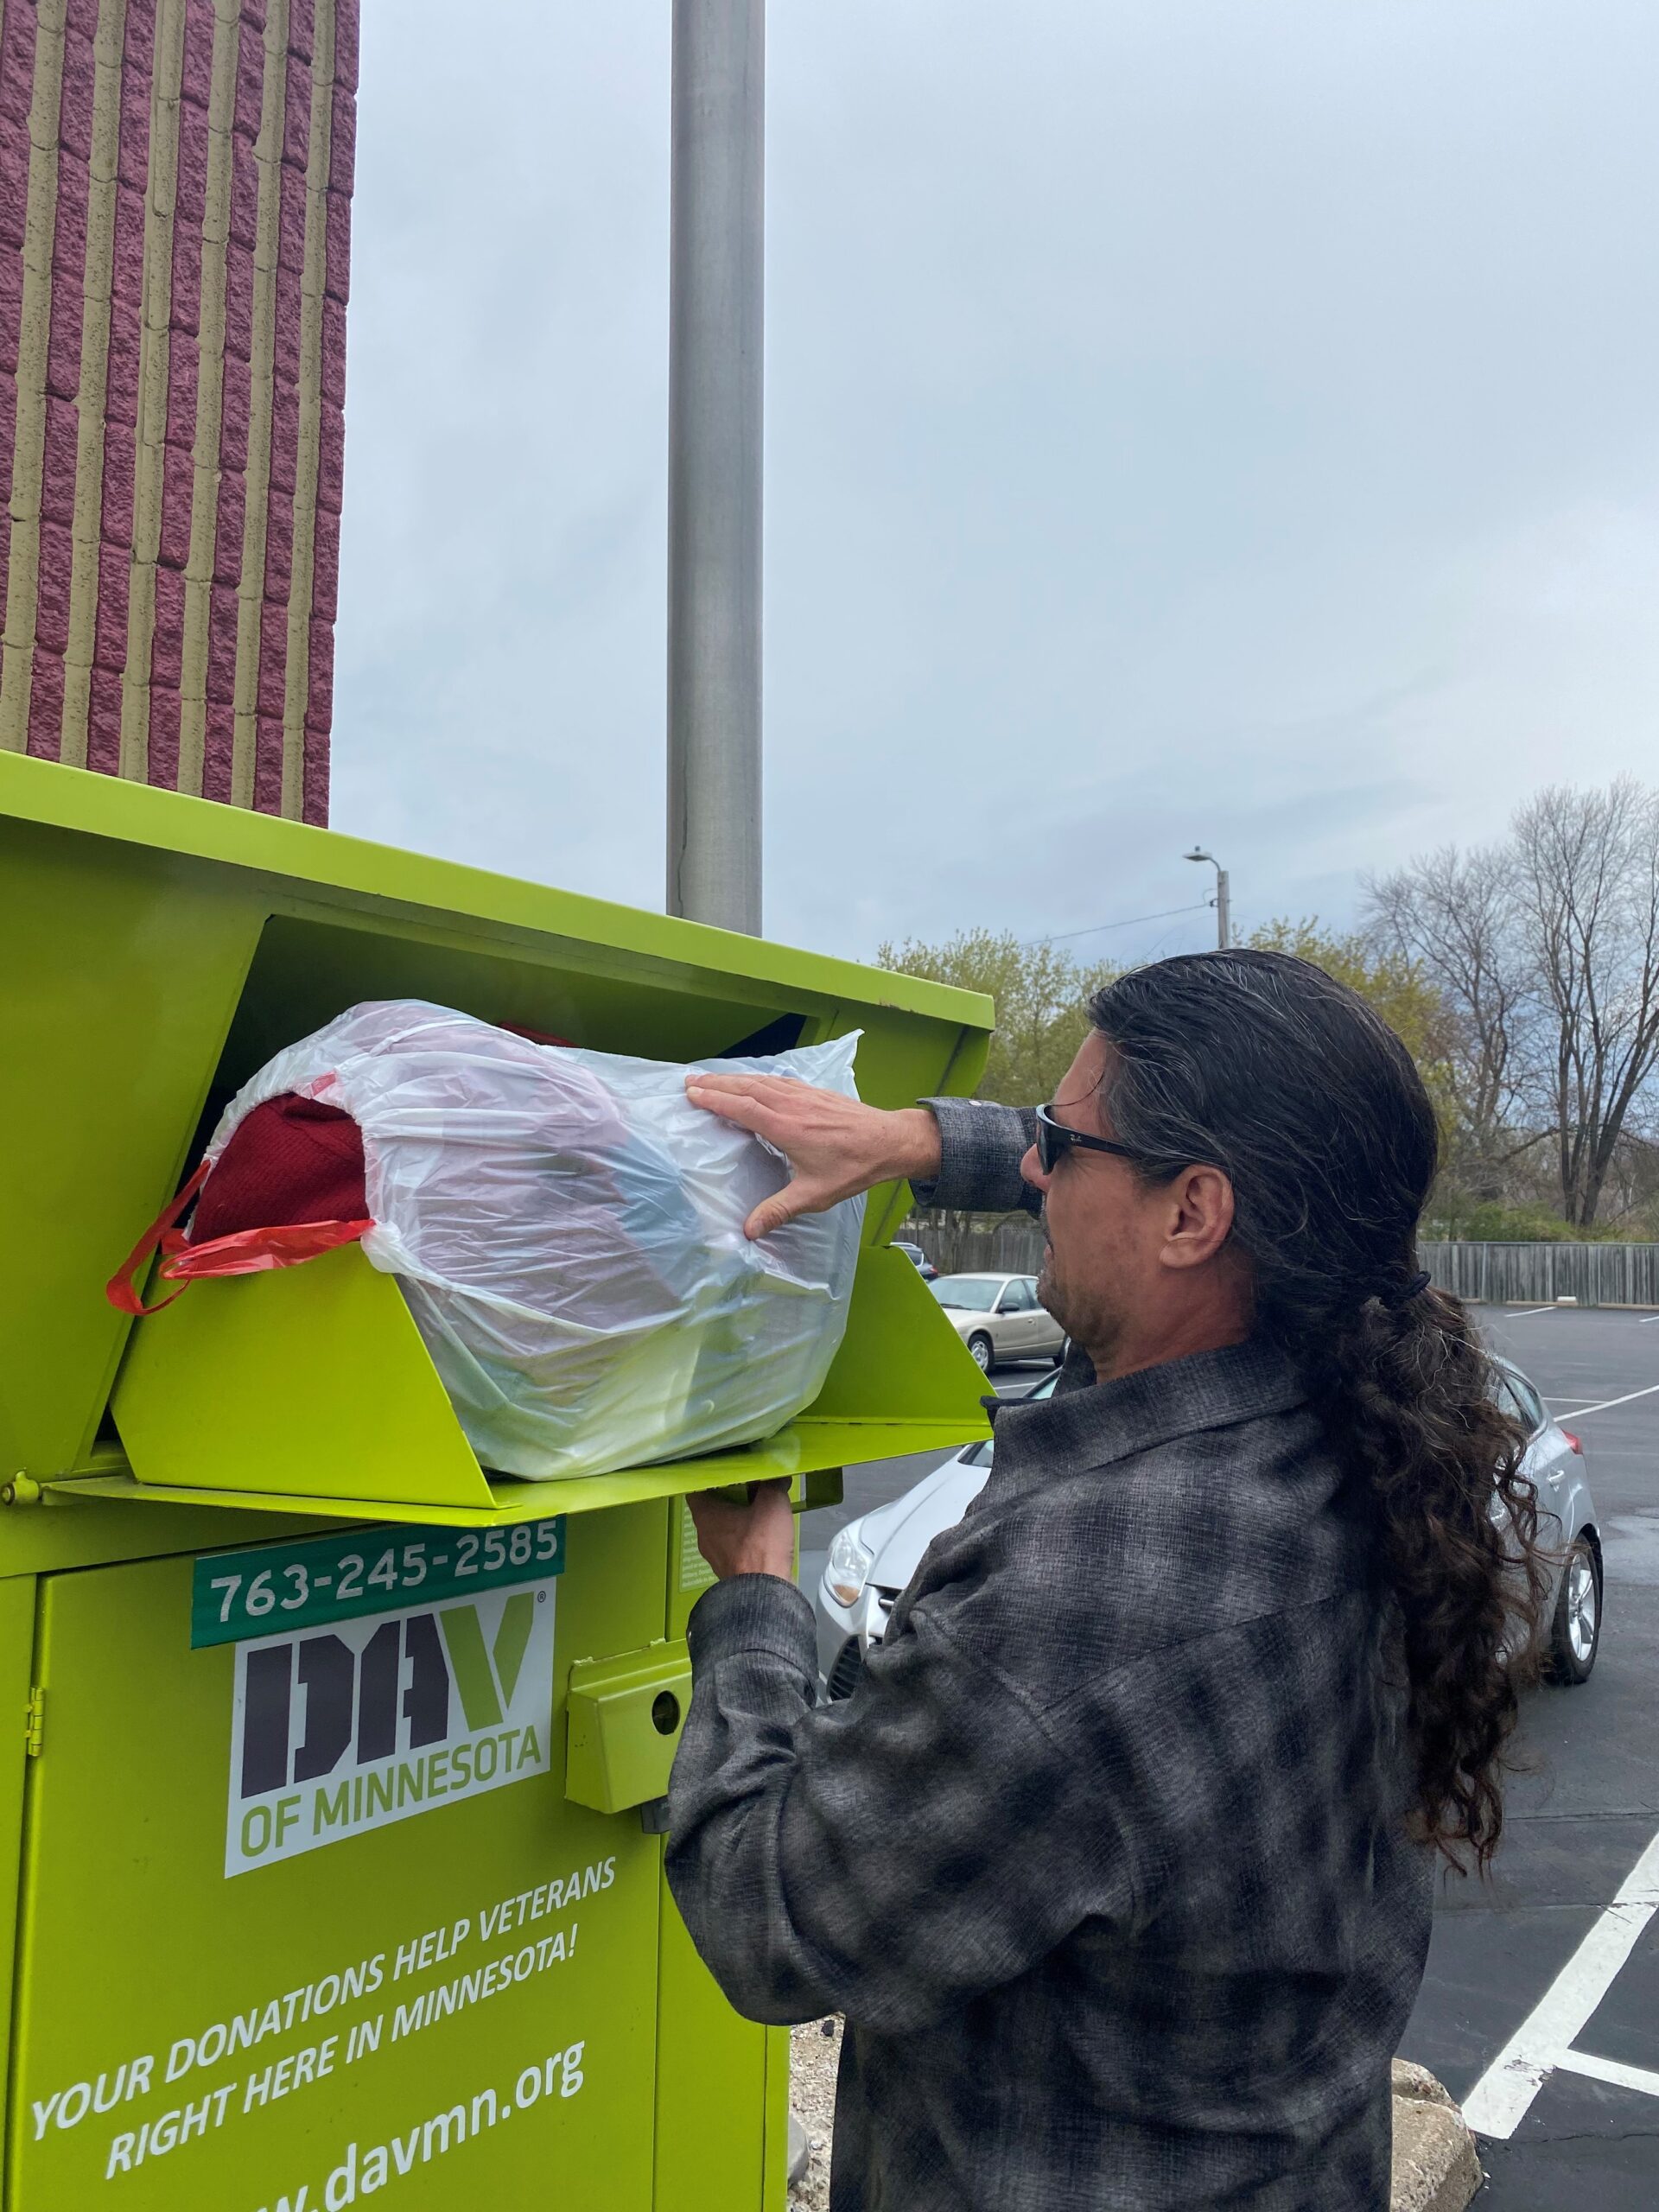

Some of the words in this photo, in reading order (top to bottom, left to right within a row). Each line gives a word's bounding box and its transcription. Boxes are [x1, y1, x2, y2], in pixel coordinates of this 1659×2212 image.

[211, 1520, 558, 1623] 763-245-2585
[240, 1795, 302, 1858] OF
[312, 1725, 542, 1836] MINNESOTA
[32, 2055, 155, 2141] YOUR
[165, 1954, 385, 2083] DONATIONS
[393, 1918, 470, 1981] HELP
[480, 1856, 616, 1942] VETERANS
[105, 2082, 238, 2180] RIGHT
[243, 2035, 339, 2113] HERE
[346, 2014, 384, 2064] IN
[391, 1923, 578, 2042] MINNESOTA!
[257, 2040, 585, 2212] davmn.org
